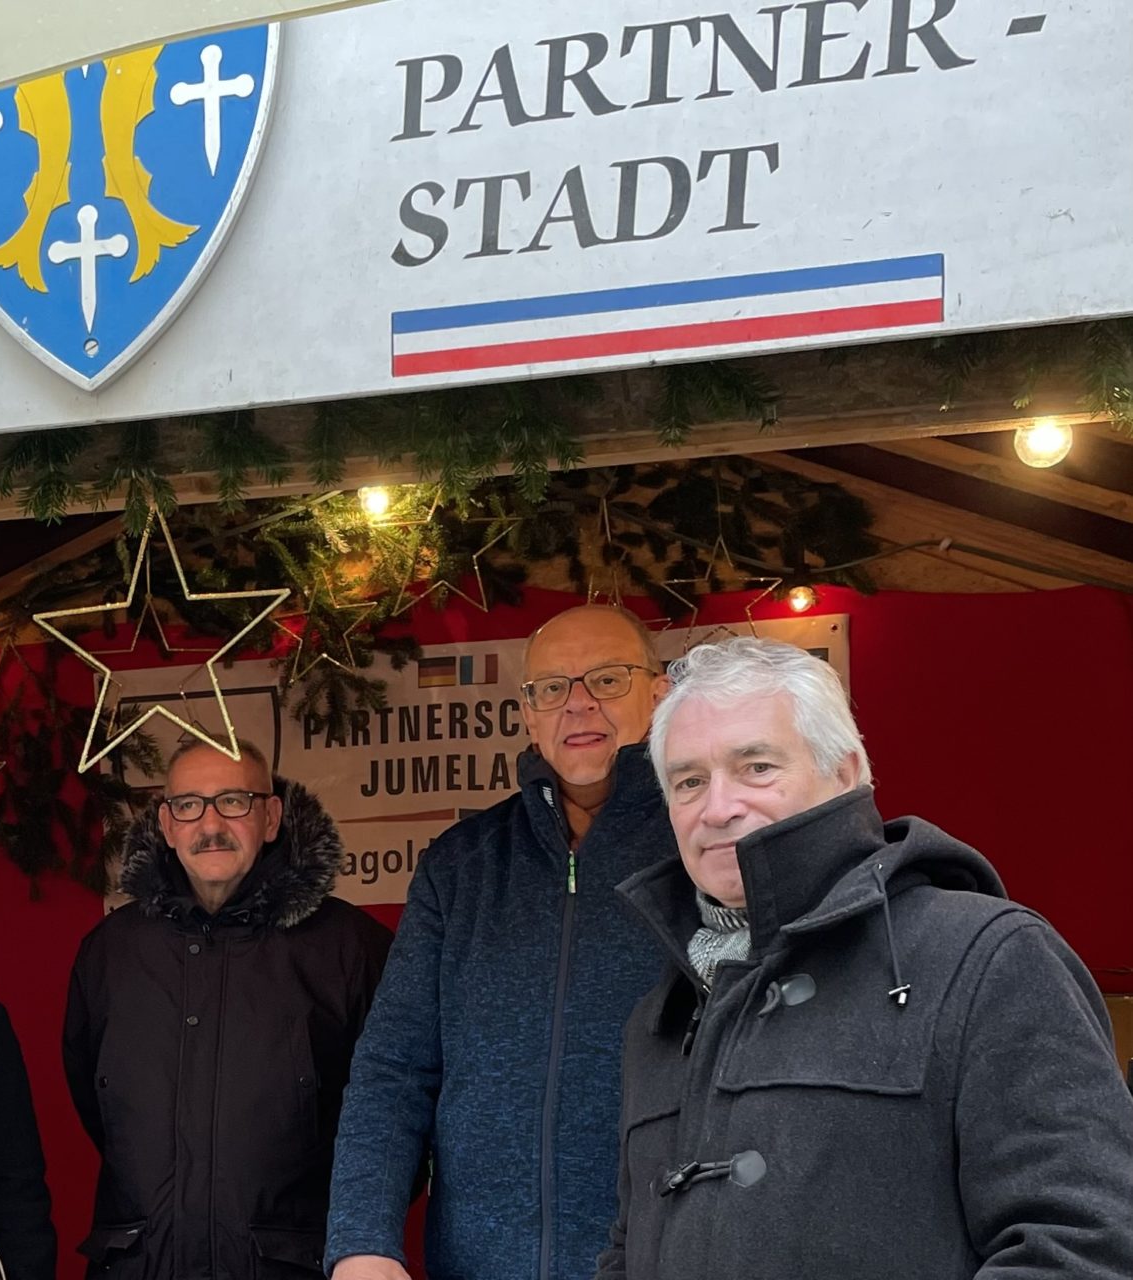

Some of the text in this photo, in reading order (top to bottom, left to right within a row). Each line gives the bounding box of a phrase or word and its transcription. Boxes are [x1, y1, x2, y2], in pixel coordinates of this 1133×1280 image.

[389, 0, 977, 143] PARTNER
[389, 142, 781, 267] STADT
[303, 698, 531, 750] PARTNERSC
[360, 752, 523, 797] JUMELA
[339, 838, 437, 885] agol
